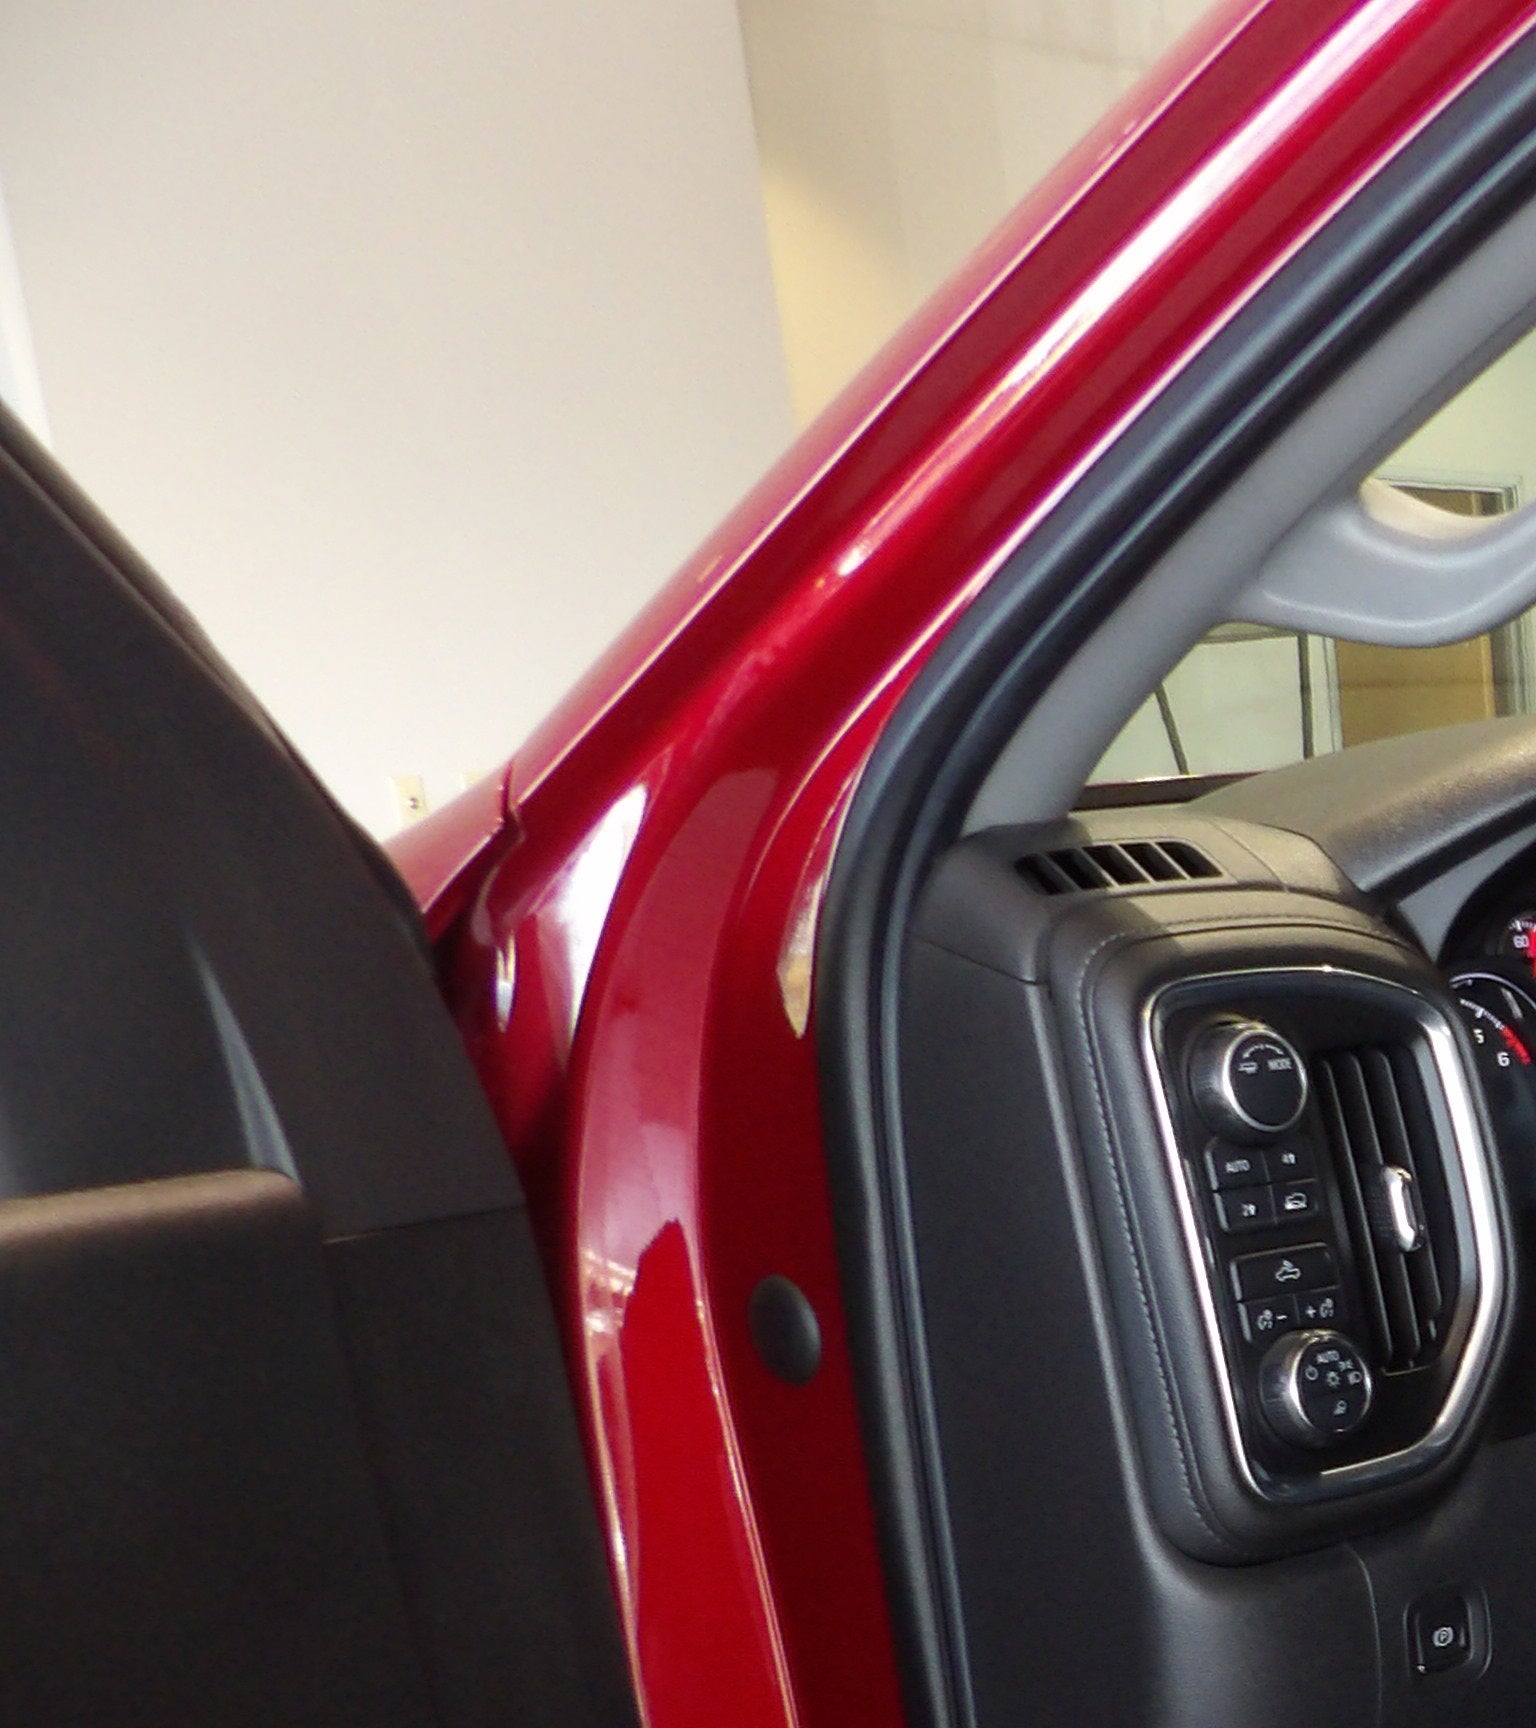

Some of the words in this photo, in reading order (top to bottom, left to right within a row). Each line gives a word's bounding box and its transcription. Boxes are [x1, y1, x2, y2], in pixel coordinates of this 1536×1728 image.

[1473, 1028, 1485, 1044] 5
[1267, 1057, 1293, 1071] MODE
[1497, 1051, 1510, 1067] 6
[1225, 1159, 1250, 1173] AUTO
